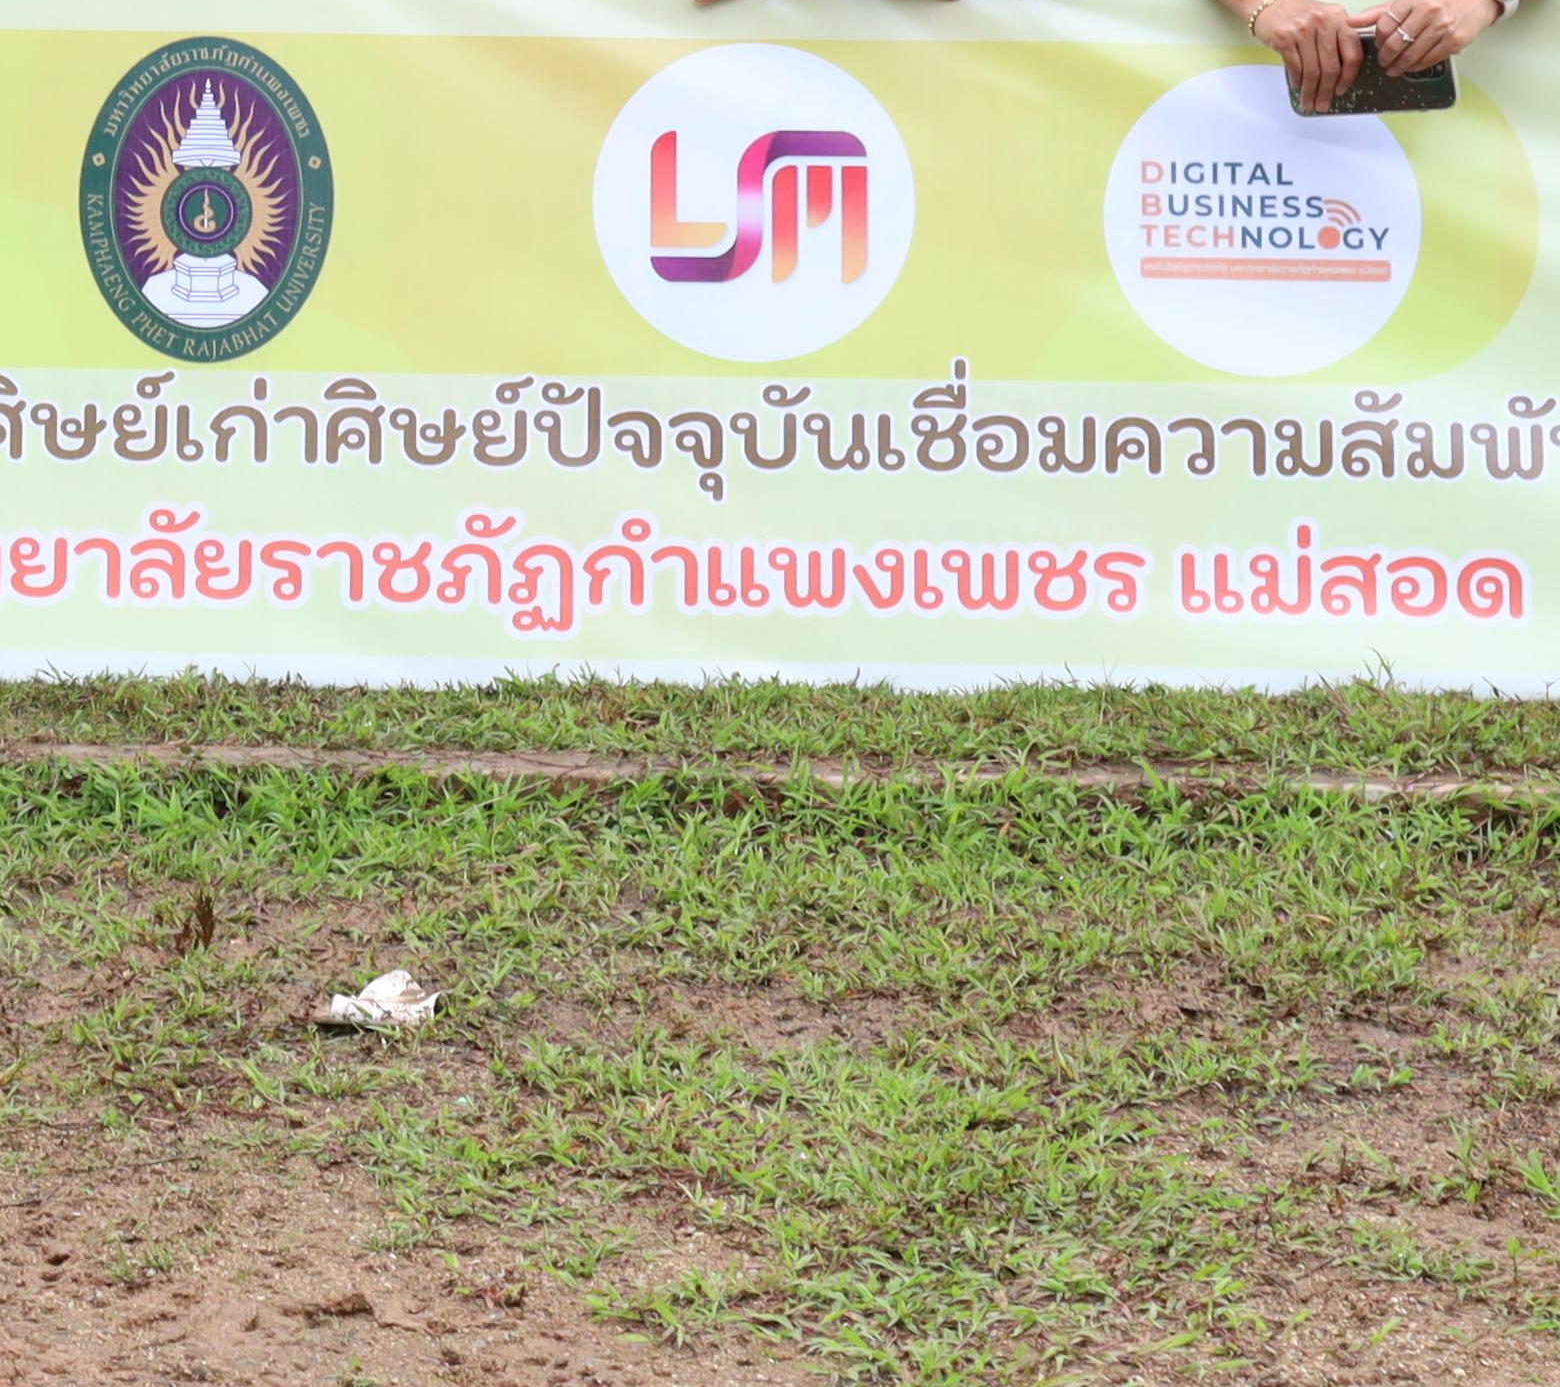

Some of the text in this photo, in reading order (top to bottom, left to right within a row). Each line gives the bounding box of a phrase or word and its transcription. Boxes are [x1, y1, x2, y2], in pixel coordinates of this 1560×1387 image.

[1140, 160, 1294, 186] DIGITAL
[1141, 193, 1324, 219] BUSINESS
[87, 193, 326, 359] KAMPHAENG PHET RAJABHAT UNIVERSITY
[1182, 524, 1525, 620] แม่สอด
